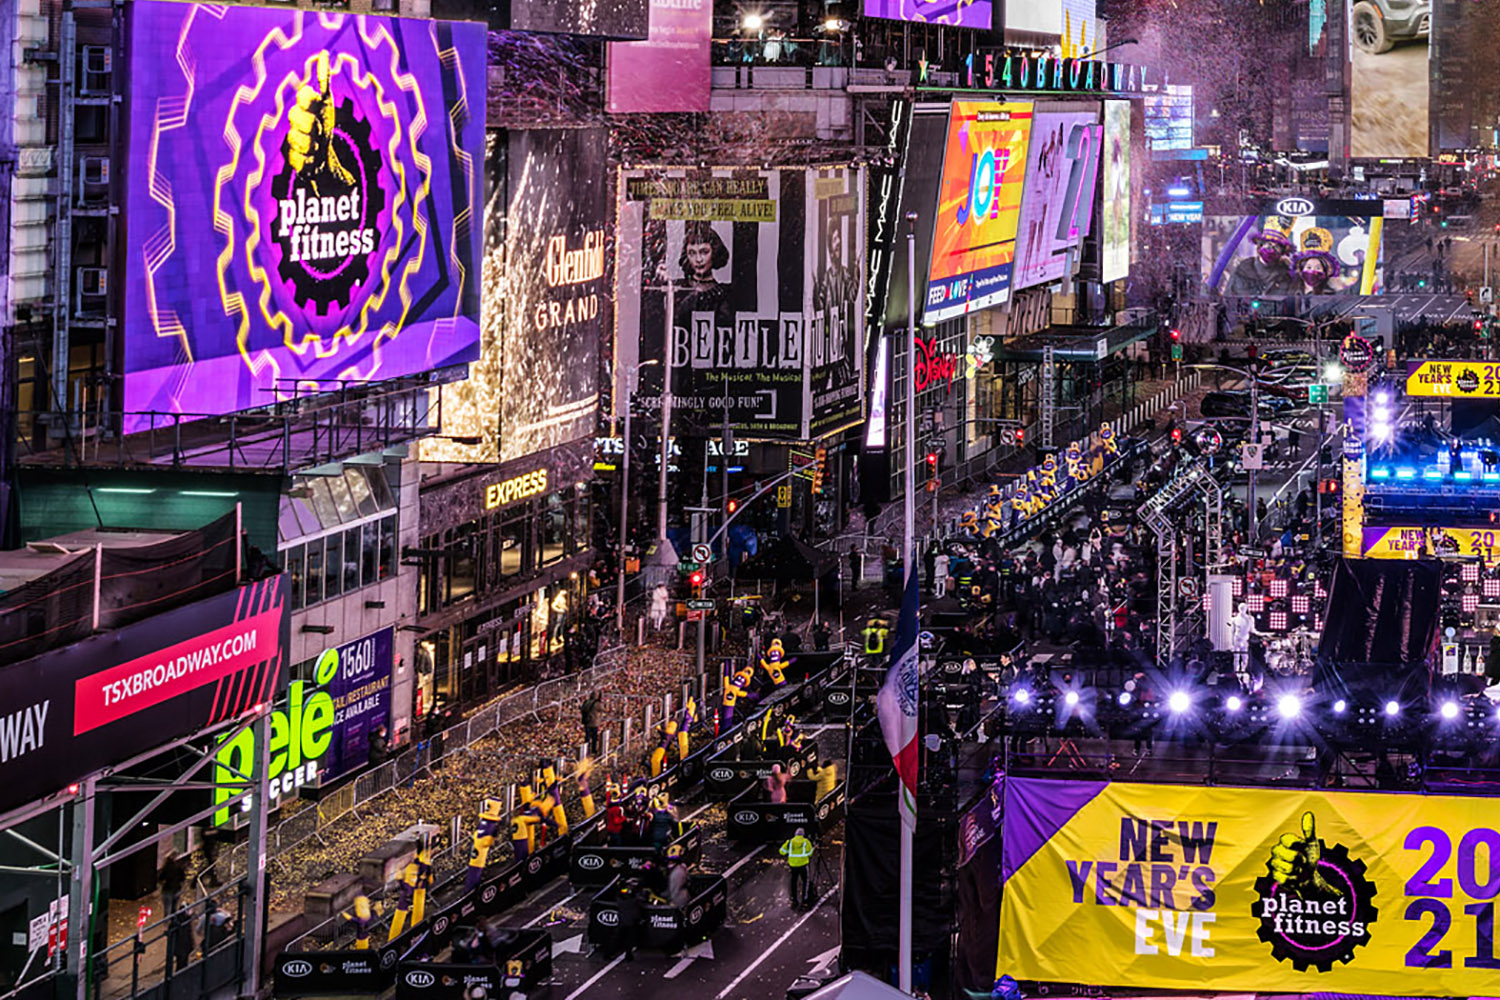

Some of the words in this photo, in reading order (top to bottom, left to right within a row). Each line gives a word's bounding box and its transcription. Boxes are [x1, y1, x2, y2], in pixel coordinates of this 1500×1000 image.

[966, 53, 1029, 88] 1540
[725, 178, 767, 195] REALLY
[956, 146, 1011, 226] JOY
[278, 192, 361, 236] planet
[710, 202, 738, 216] FEEL
[739, 203, 774, 218] ALIVE!
[1280, 201, 1310, 214] KIA
[290, 226, 375, 264] fitness
[535, 293, 598, 332] GRAND
[1418, 373, 1452, 384] YEAR'S
[1429, 364, 1452, 374] NEW
[1433, 383, 1452, 394] EVE
[486, 468, 548, 511] EXPRESS
[1400, 529, 1424, 540] NEW
[1470, 531, 1495, 548] 20
[102, 629, 258, 707] TSXBROADWAY.COM
[340, 637, 371, 681] 1560
[241, 760, 319, 812] SCCER
[1117, 817, 1219, 864] NEW
[581, 857, 601, 868] KIA
[1064, 859, 1218, 913] YEAR'S
[650, 914, 674, 925] planet
[1260, 893, 1348, 926] planet
[653, 920, 678, 930] fitness
[1134, 910, 1217, 958] EVE
[1273, 911, 1366, 939] fitness
[285, 961, 309, 975] KIA
[408, 972, 432, 987] KIA
